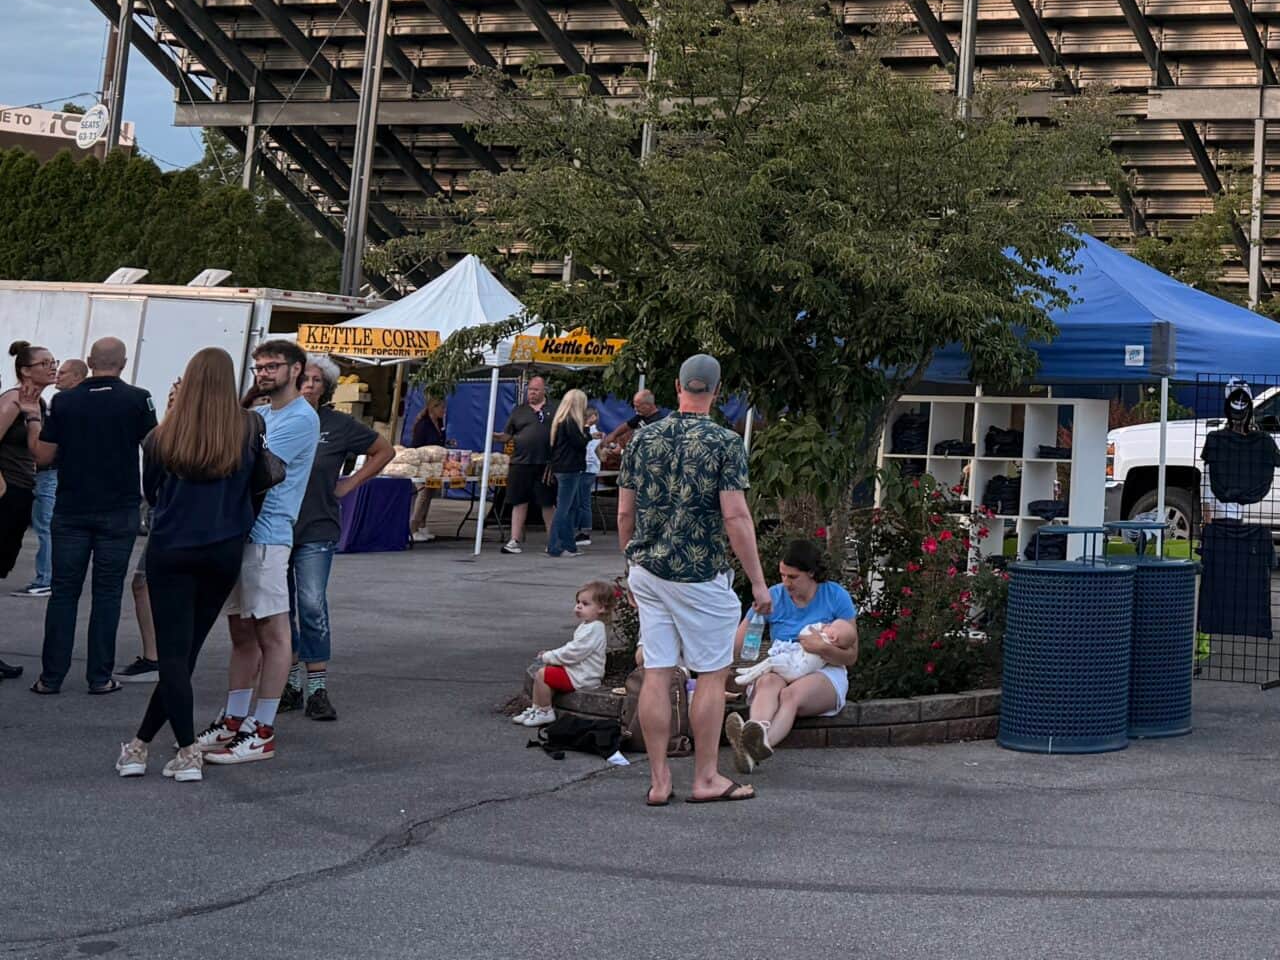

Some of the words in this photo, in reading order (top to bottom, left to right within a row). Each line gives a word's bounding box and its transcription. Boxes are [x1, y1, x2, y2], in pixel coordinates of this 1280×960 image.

[14, 113, 32, 125] TO
[81, 121, 100, 129] SEATS
[305, 325, 373, 346] KETTLE
[382, 328, 430, 349] CORN
[353, 347, 367, 355] THE
[371, 348, 410, 357] POPCORN
[542, 339, 582, 355] Kettle
[584, 340, 615, 356] Corn
